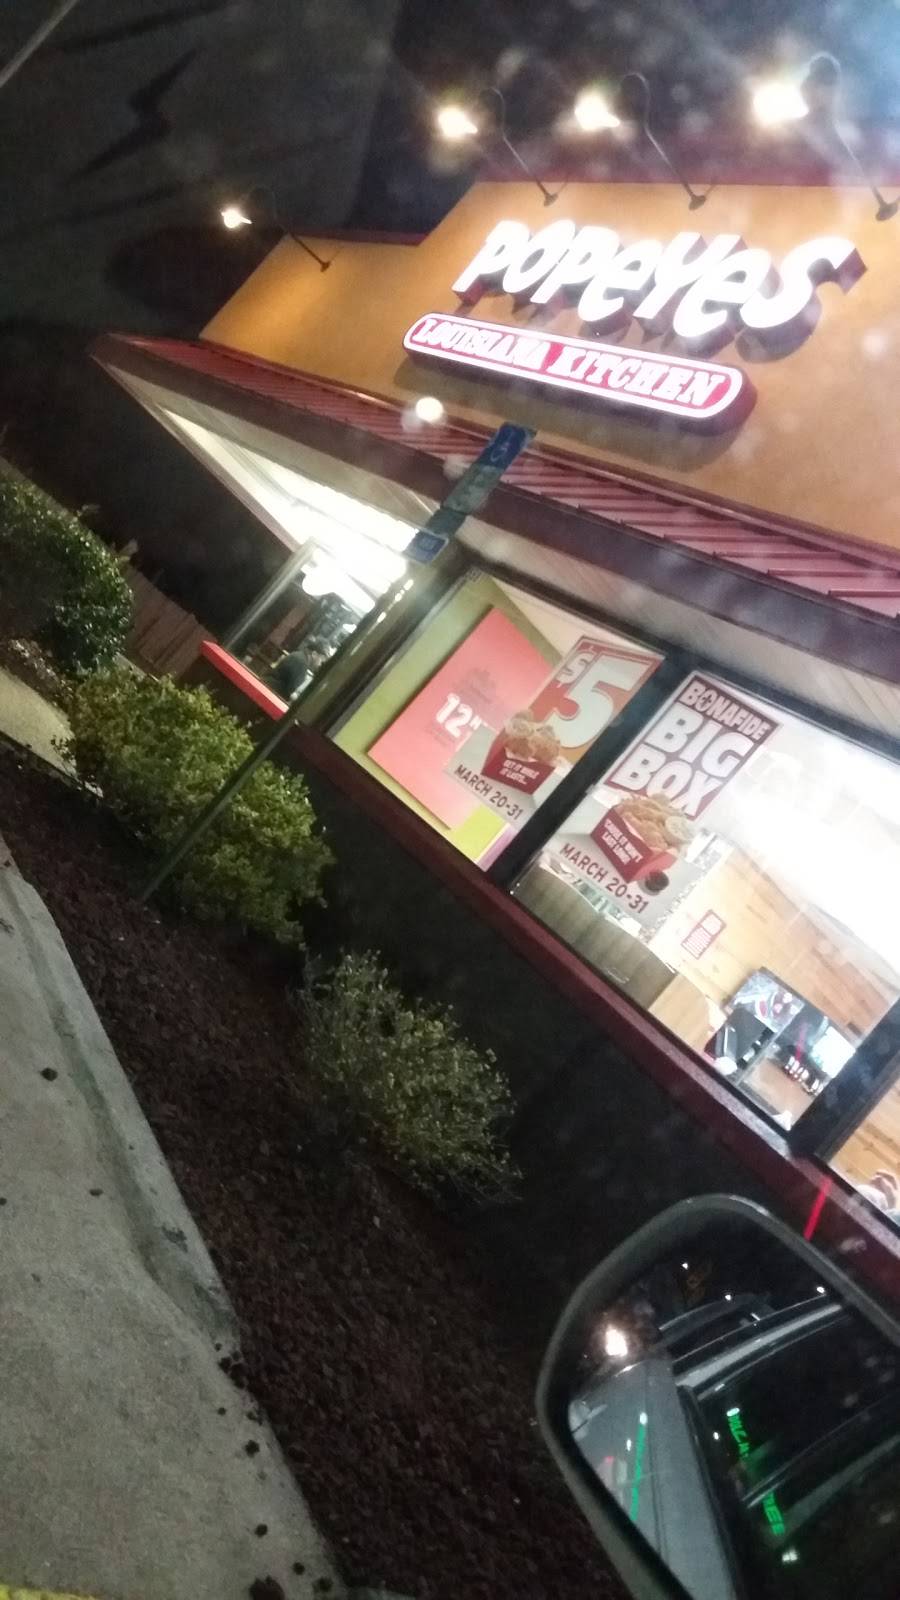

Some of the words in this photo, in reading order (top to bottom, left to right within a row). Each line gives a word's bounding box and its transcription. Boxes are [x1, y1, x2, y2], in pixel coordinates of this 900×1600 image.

[411, 316, 551, 372] LOUISIANA
[546, 340, 726, 408] KITCHEN
[646, 701, 755, 778] BIG
[679, 680, 773, 741] BONAFIDE
[454, 764, 492, 797] MARCH
[489, 790, 524, 821] 20-31
[610, 742, 722, 817] BOX
[559, 843, 607, 882] MARCH
[604, 877, 650, 914] 20-31
